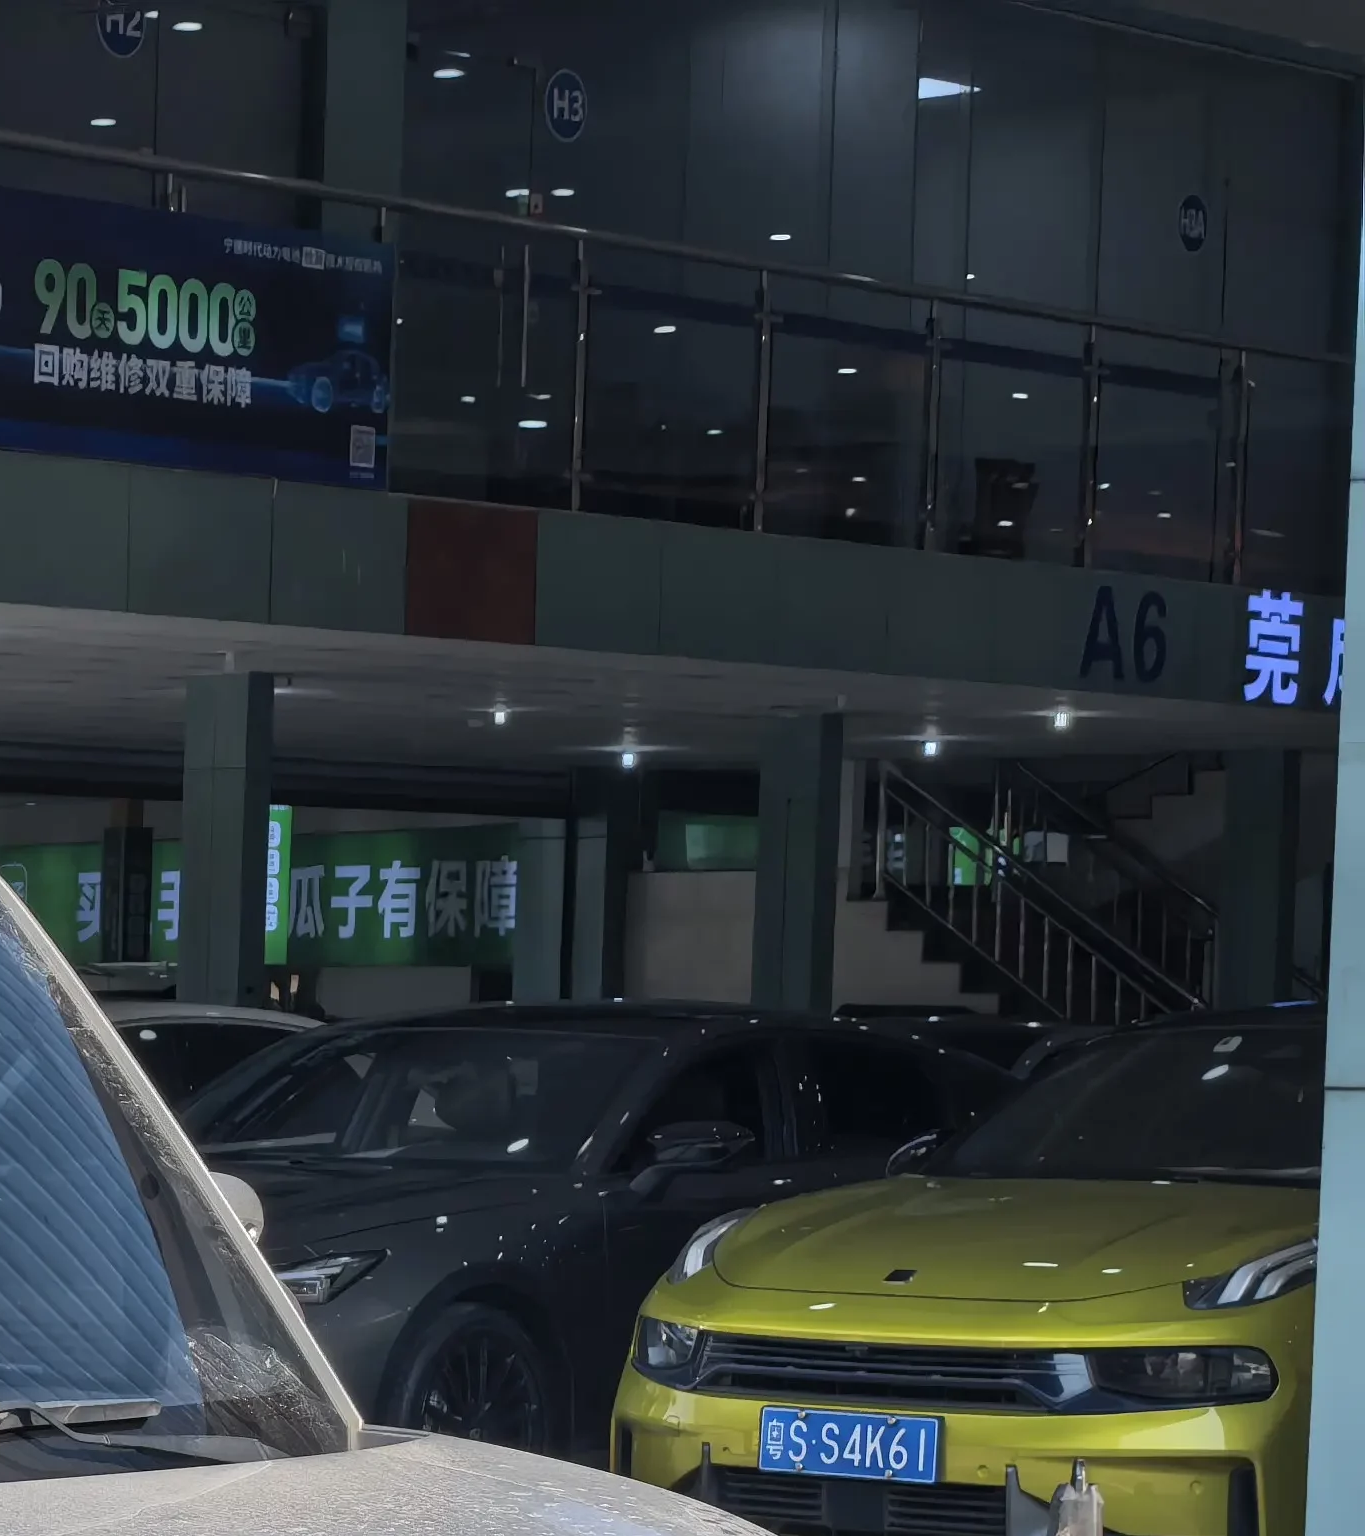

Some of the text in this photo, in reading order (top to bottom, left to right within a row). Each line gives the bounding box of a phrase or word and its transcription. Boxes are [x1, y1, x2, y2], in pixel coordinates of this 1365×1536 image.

[553, 88, 584, 122] H3
[33, 342, 252, 409] 回购维修双重保障
[1080, 586, 1166, 683] A6
